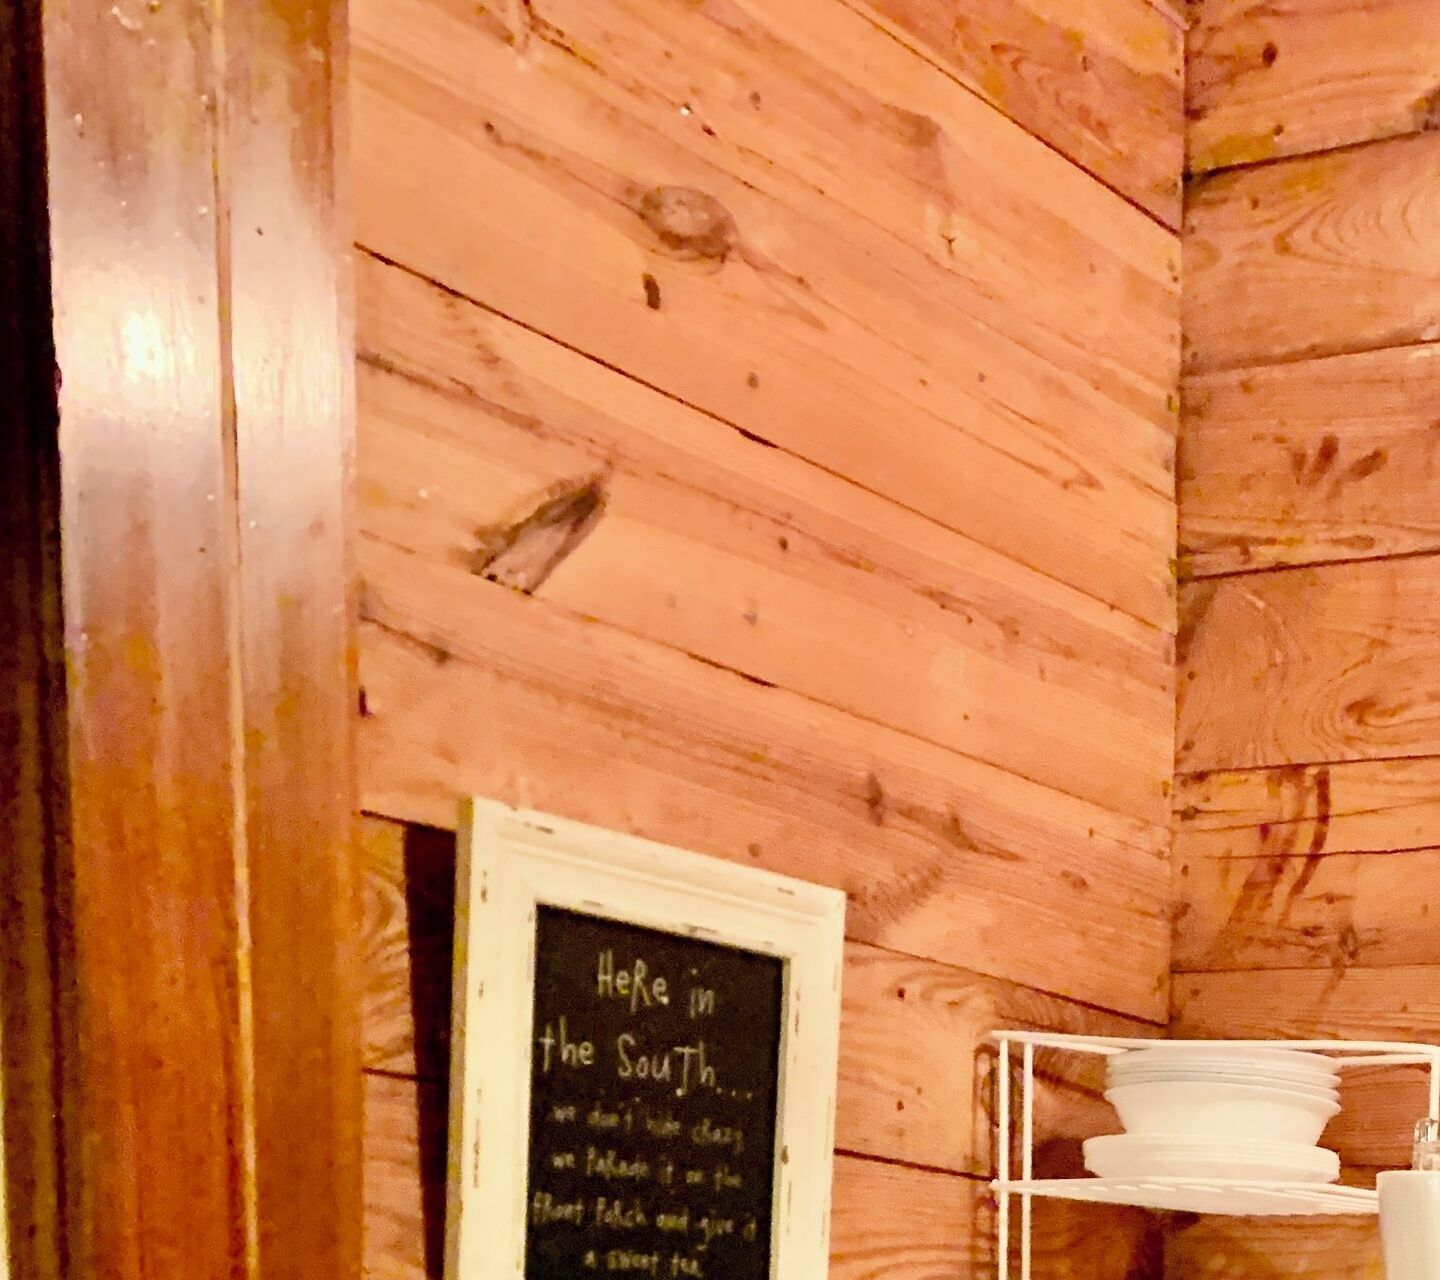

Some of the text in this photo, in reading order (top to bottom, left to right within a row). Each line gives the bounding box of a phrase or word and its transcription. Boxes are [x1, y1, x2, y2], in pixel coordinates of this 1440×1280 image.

[690, 967, 715, 1019] in
[538, 1014, 596, 1073] the
[552, 1105, 576, 1123] we
[552, 1152, 576, 1169] we
[655, 1206, 689, 1236] and
[607, 1248, 660, 1278] sweet
